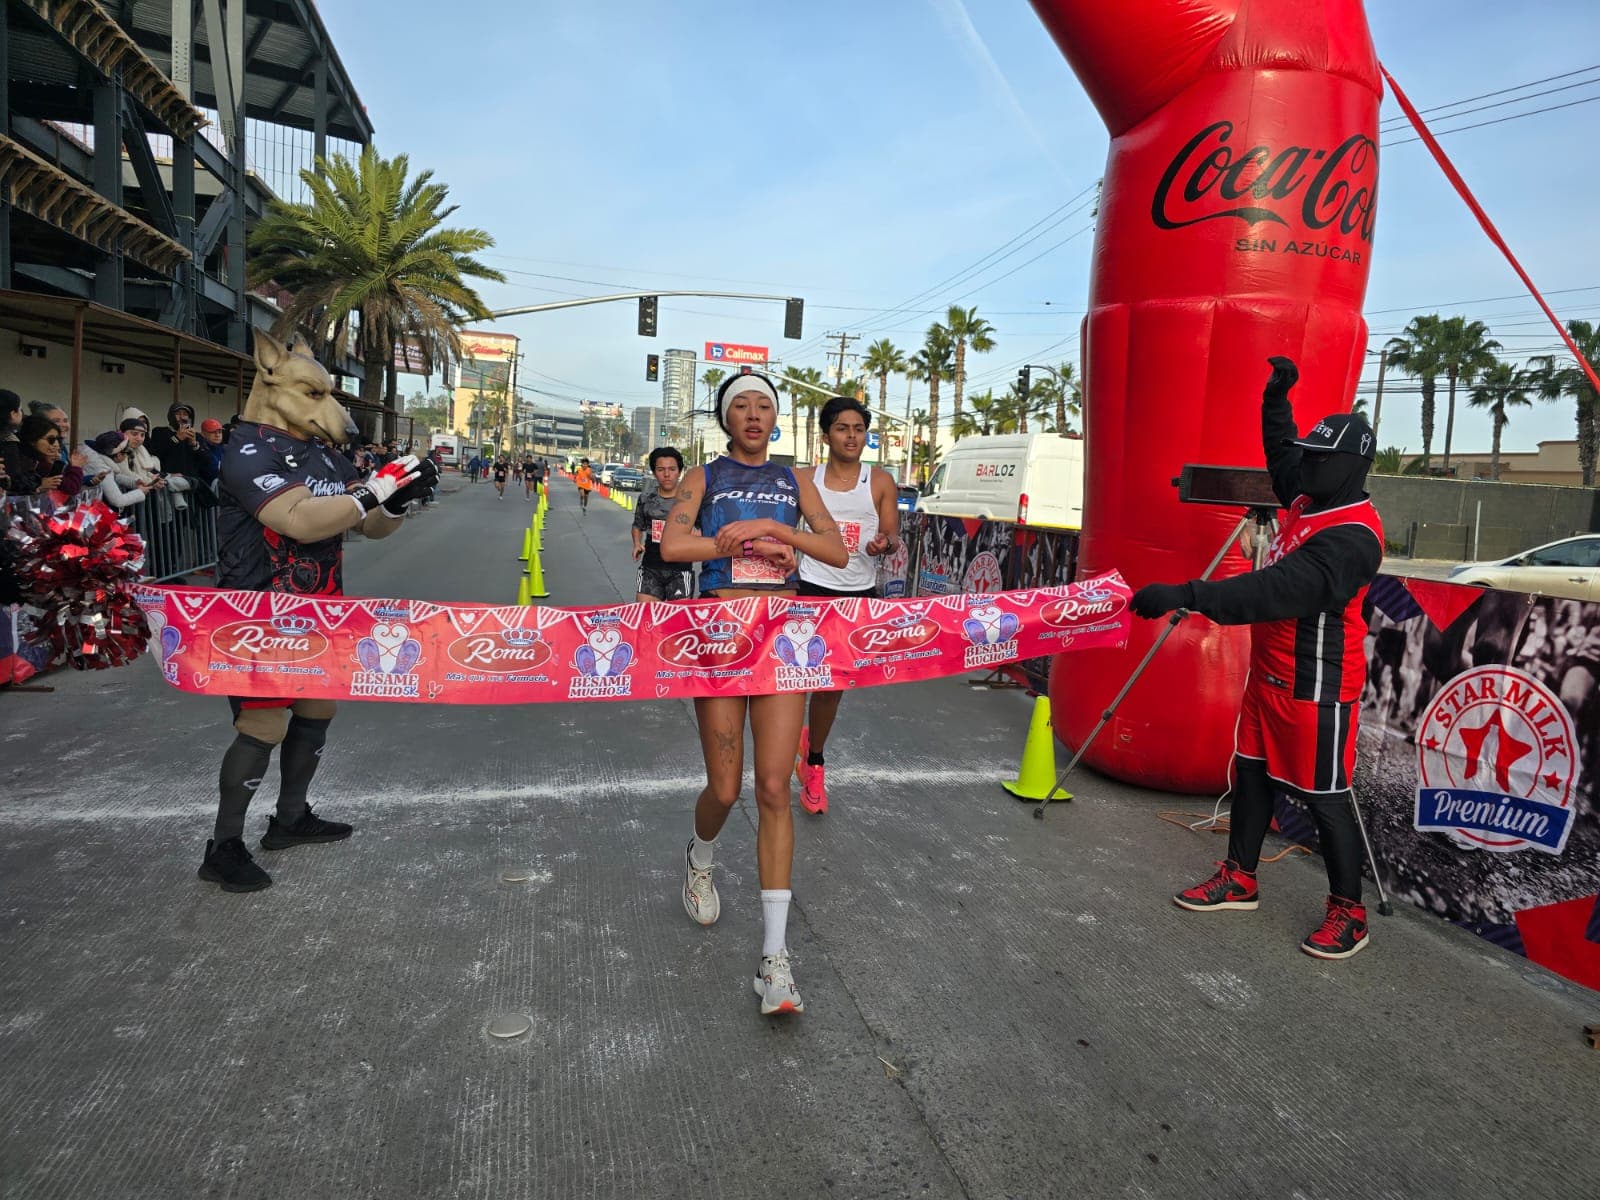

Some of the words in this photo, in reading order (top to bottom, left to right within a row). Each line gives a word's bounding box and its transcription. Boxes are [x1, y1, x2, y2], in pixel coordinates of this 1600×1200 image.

[1151, 120, 1378, 243] Coca-Col
[1236, 238, 1276, 253] SIN
[1284, 240, 1361, 265] AZÚCAR
[725, 347, 765, 361] Calimax
[976, 463, 1016, 476] BARLOZ
[1054, 598, 1114, 625] Roma
[229, 625, 311, 653] Roma
[673, 633, 738, 662] Roma
[863, 623, 927, 650] Roma
[966, 640, 1018, 658] BÉSAME
[463, 637, 536, 664] Roma
[353, 669, 419, 686] BÉSAME
[572, 674, 631, 688] BÉSAME
[777, 663, 831, 679] BÉSAME
[1434, 676, 1499, 730] STAR
[1502, 680, 1568, 761] MILK
[1434, 790, 1550, 838] Premium
